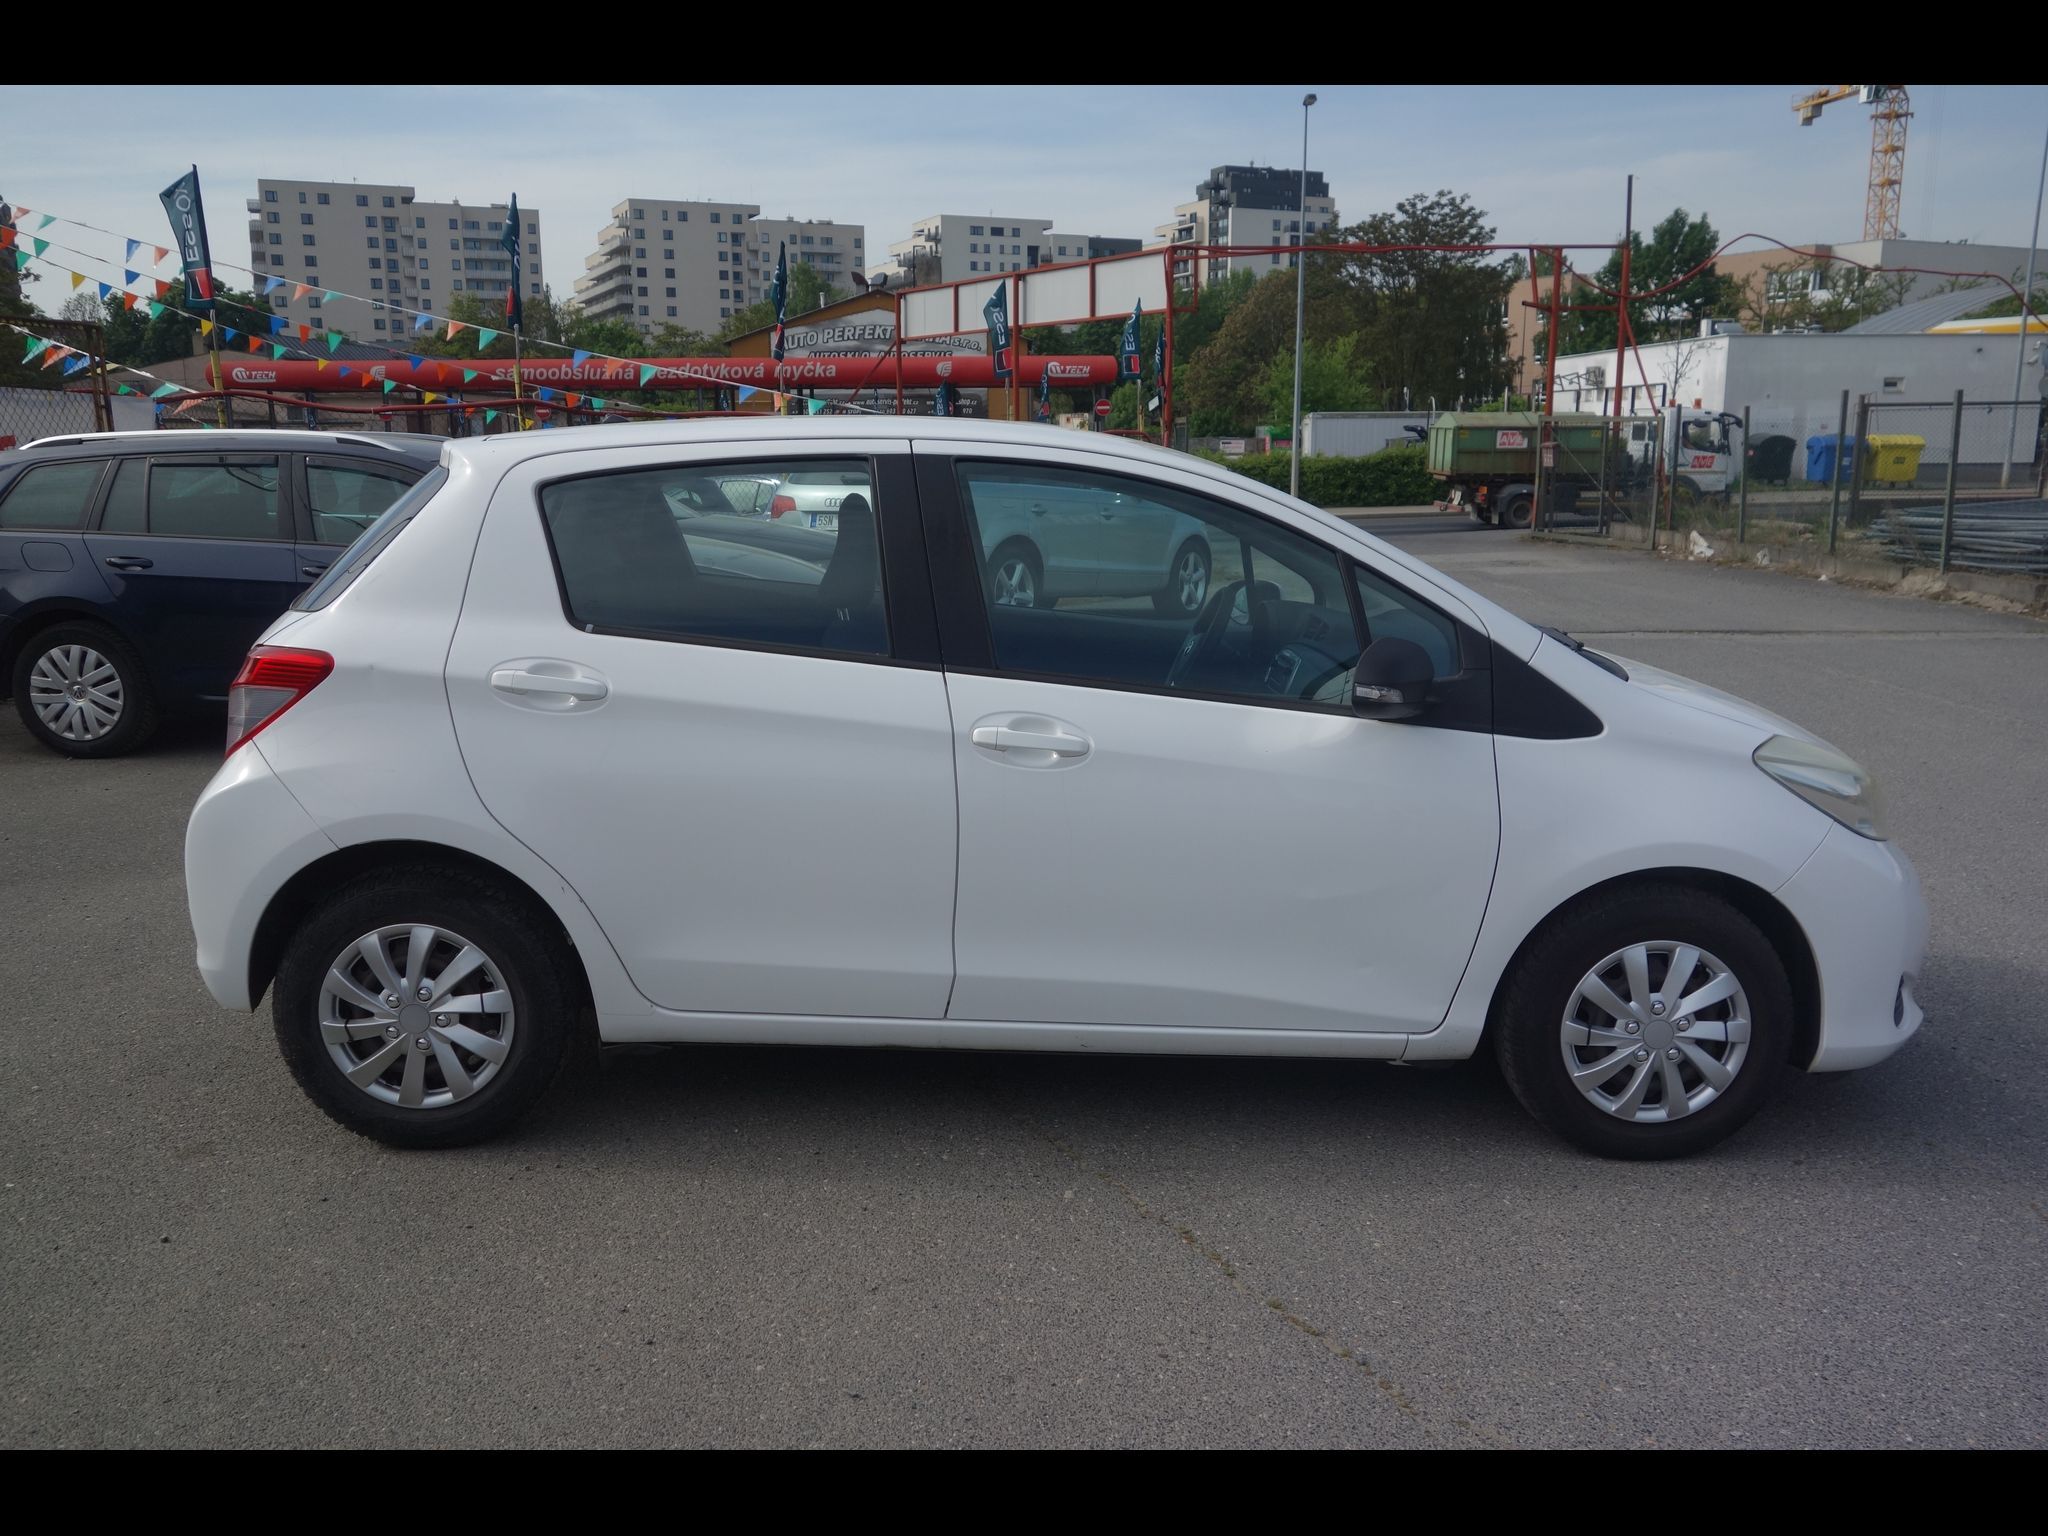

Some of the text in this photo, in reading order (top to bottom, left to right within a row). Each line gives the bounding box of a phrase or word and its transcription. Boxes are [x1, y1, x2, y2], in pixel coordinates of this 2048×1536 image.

[823, 325, 895, 343] PERFEKT
[952, 337, 981, 351] s.r.o.
[495, 361, 837, 381] samoobslužná ezdotyková myčka
[818, 515, 834, 526] 5SN
